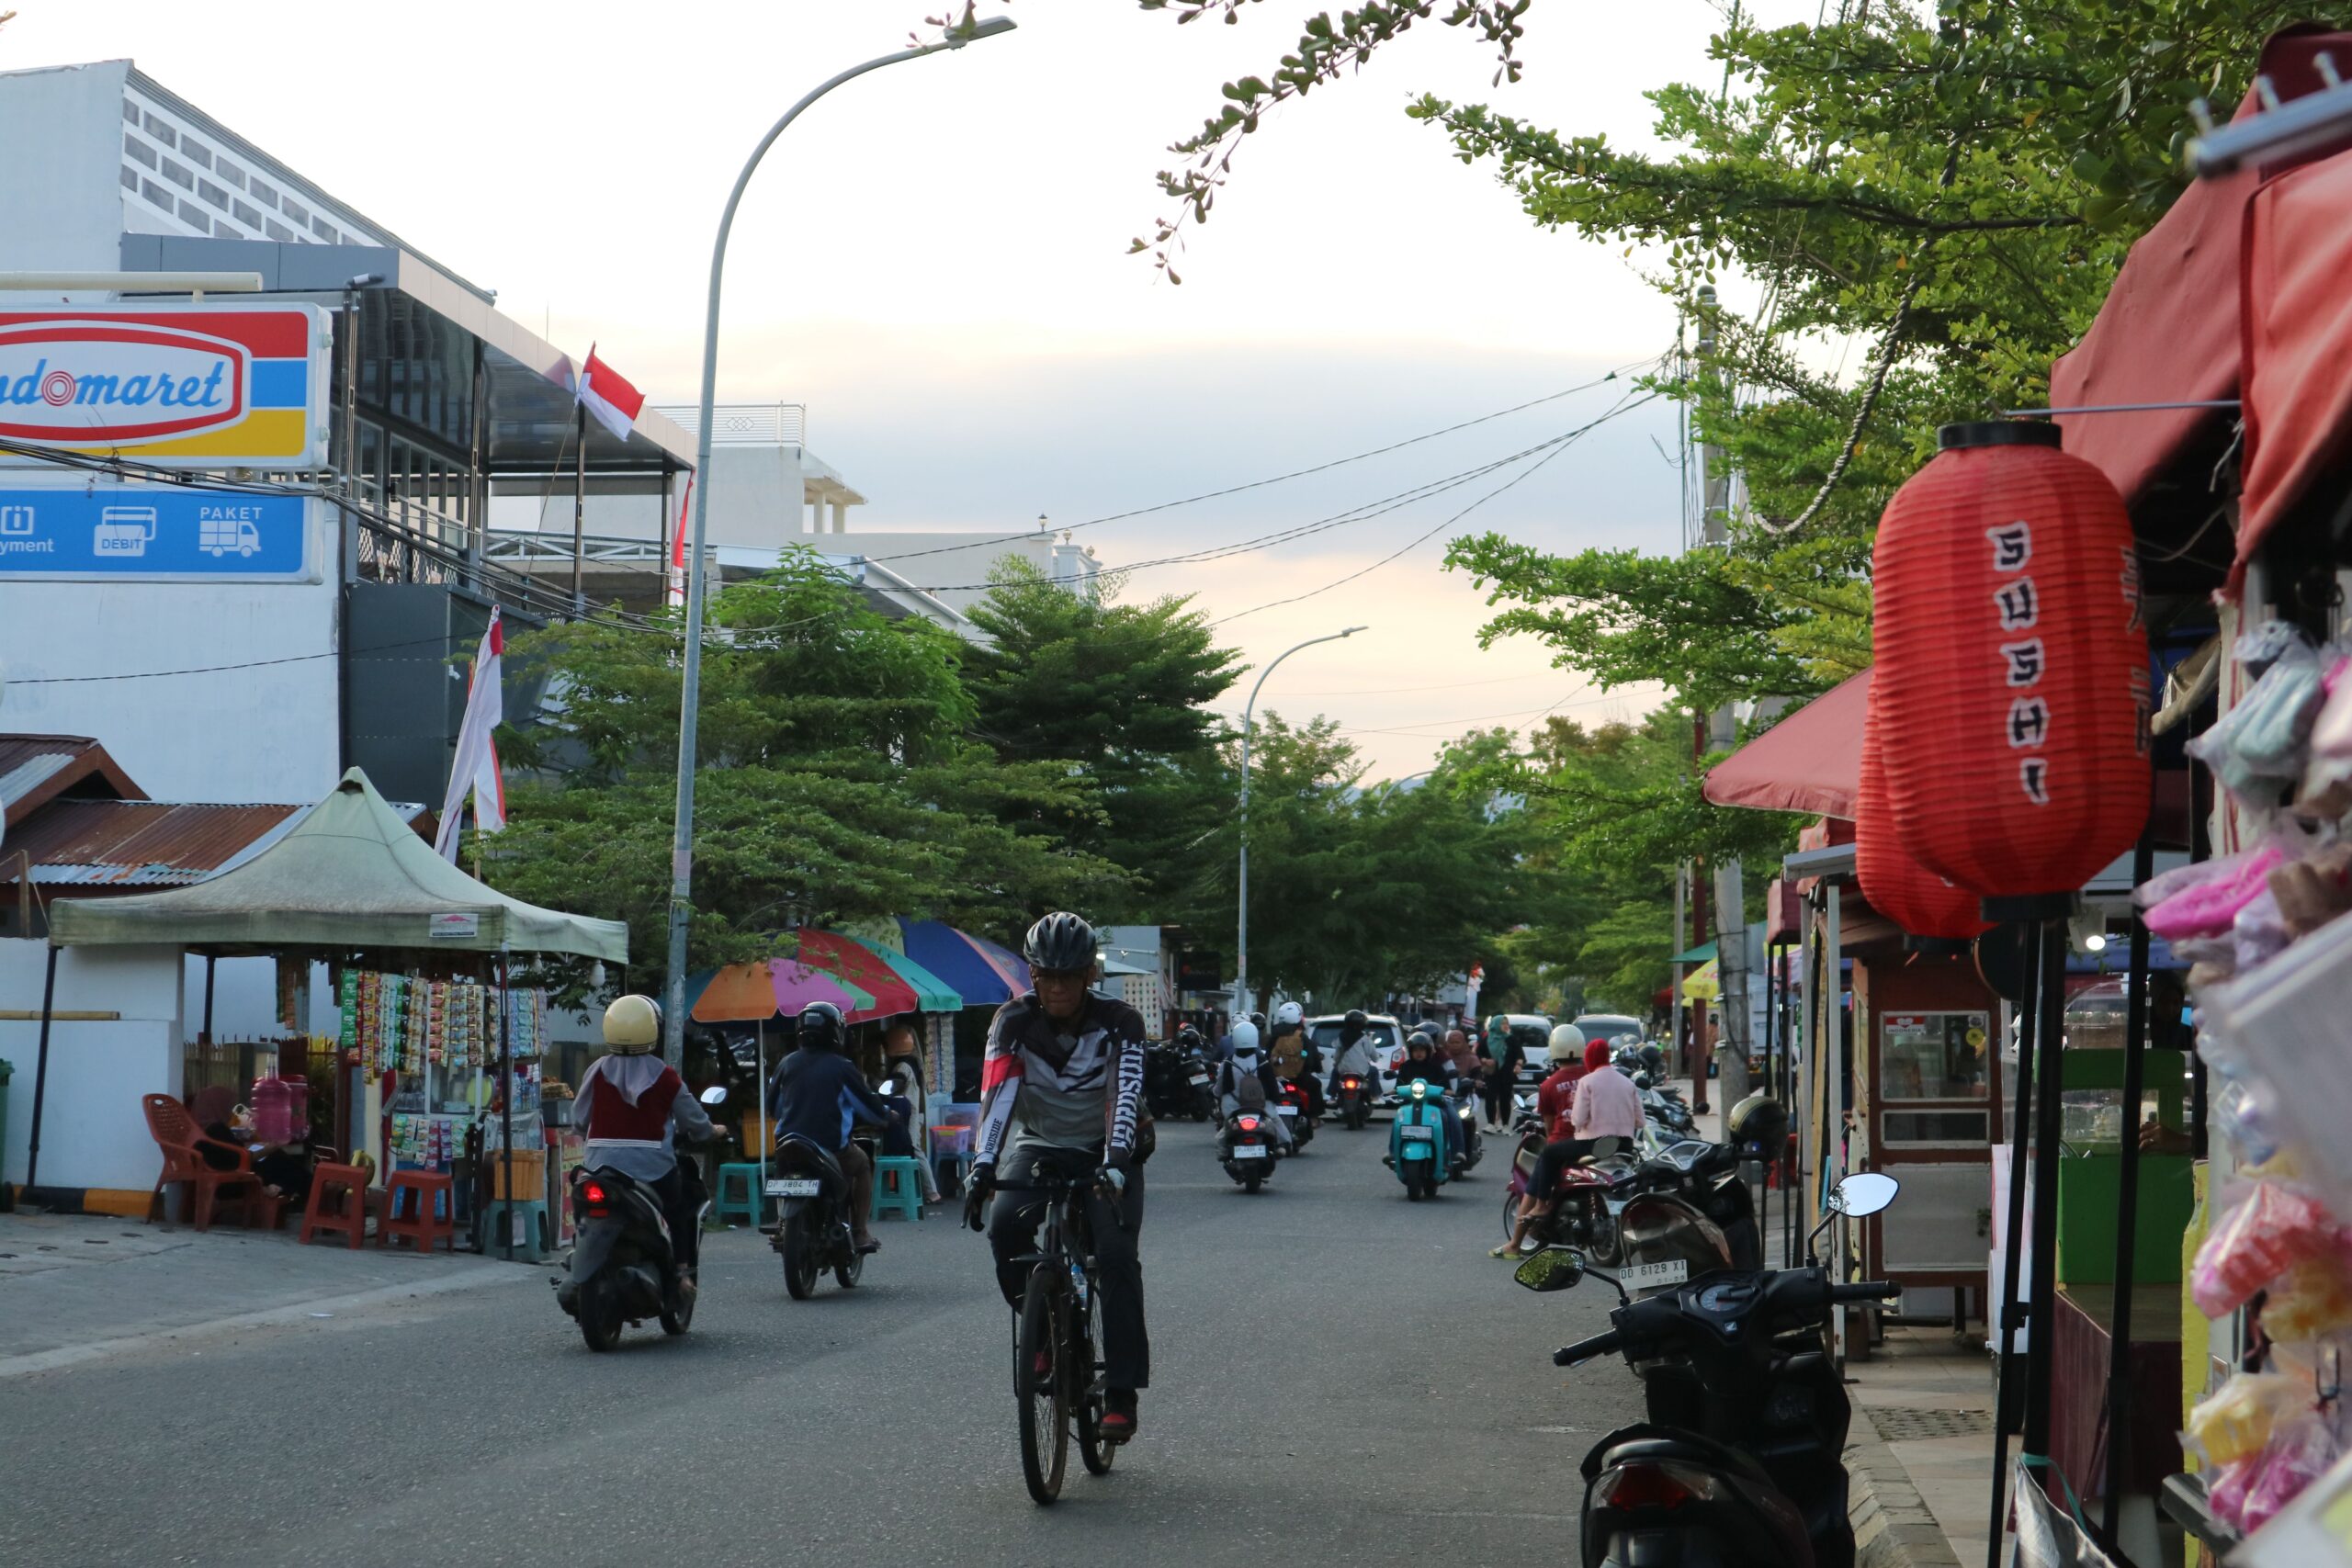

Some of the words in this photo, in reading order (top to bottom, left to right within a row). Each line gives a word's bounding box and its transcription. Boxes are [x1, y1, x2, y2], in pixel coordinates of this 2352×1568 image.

[199, 507, 264, 520] PAKET
[101, 538, 143, 549] DEBIT
[1989, 523, 2047, 804] SUSHI
[1621, 1268, 1634, 1280] DD
[1641, 1263, 1668, 1276] 6129
[1672, 1259, 1686, 1271] XI
